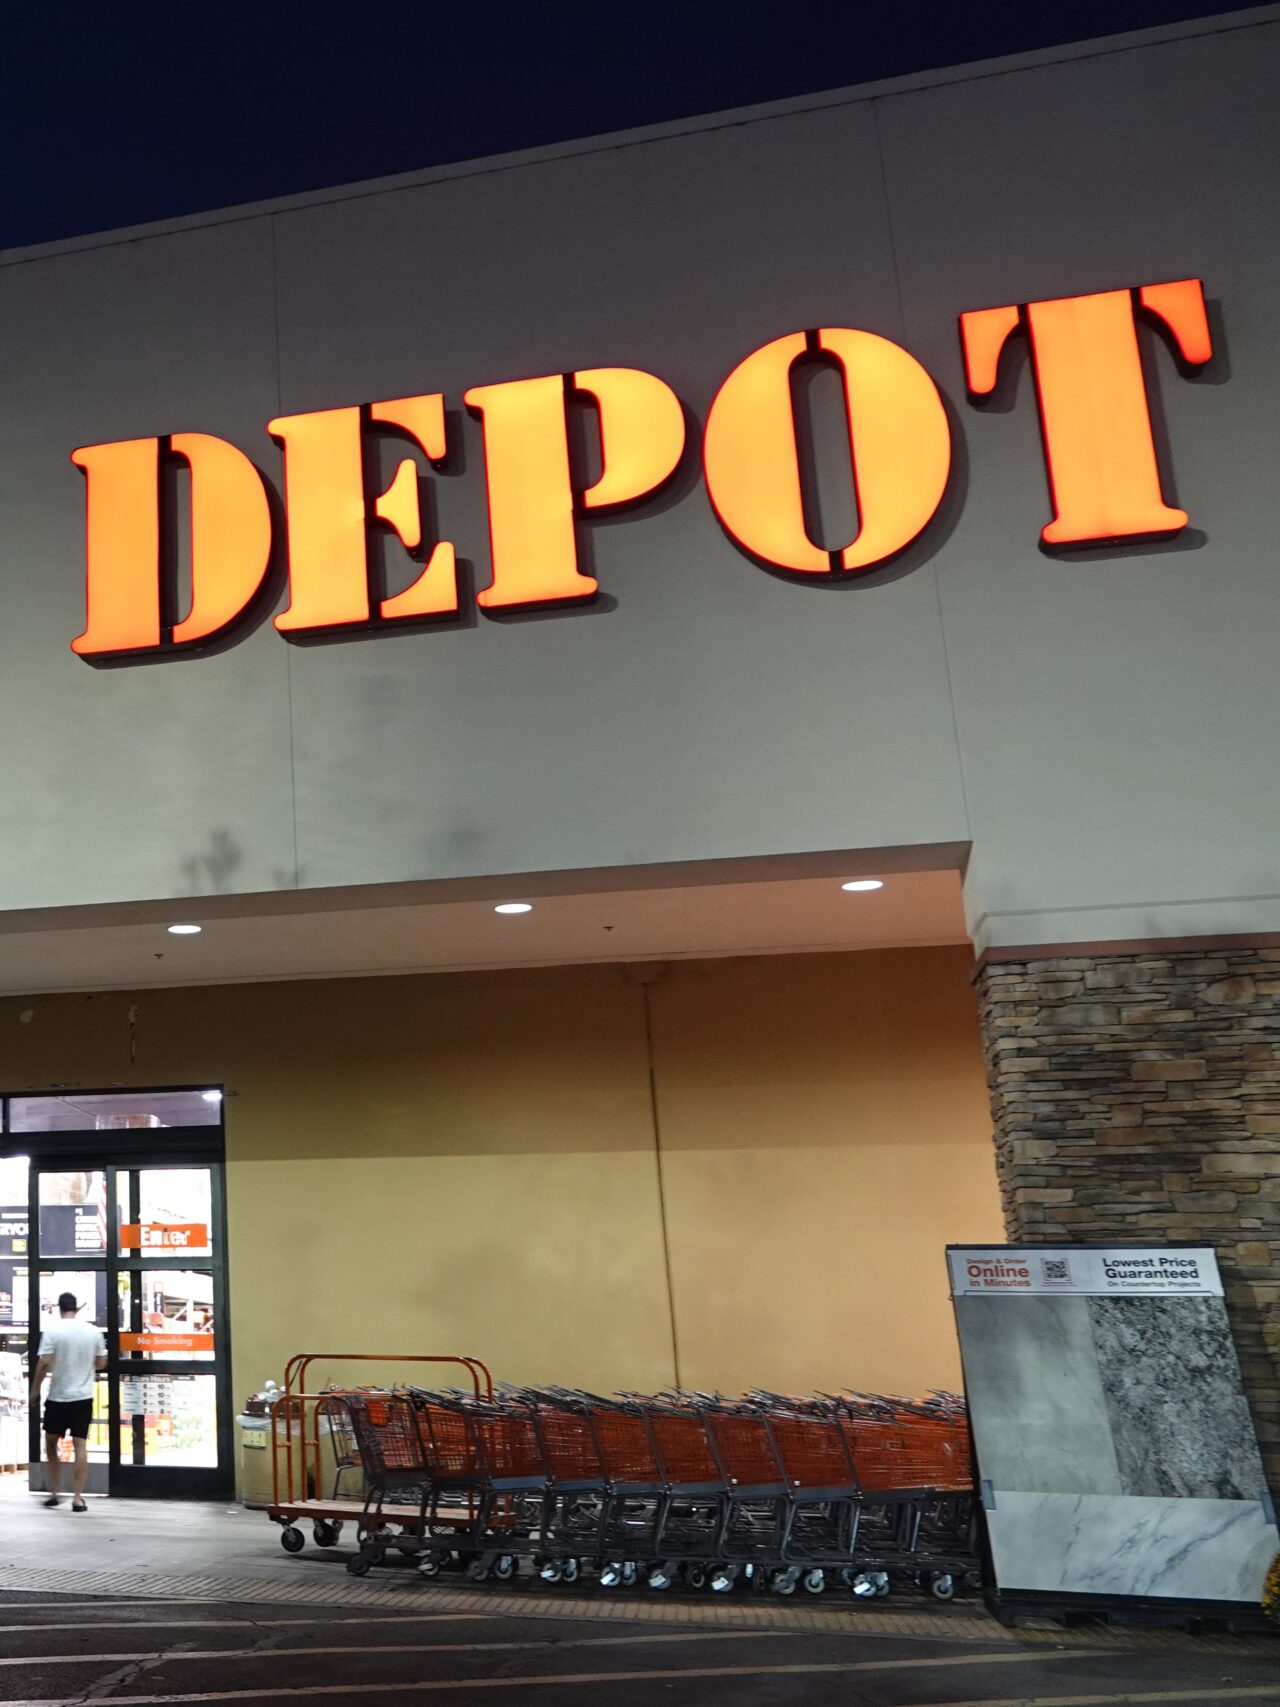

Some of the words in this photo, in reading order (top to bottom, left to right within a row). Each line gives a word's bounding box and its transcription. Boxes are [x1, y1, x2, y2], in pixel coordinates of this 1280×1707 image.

[70, 278, 1213, 655] DEPOT
[0, 1222, 29, 1236] RYO
[140, 1226, 191, 1247] Enter
[1102, 1257, 1155, 1268] Lowest
[1158, 1257, 1198, 1268] Price
[966, 1264, 1030, 1278] Online
[1104, 1267, 1199, 1280] Guaranteed
[970, 1278, 981, 1287] in
[983, 1278, 1032, 1288] Minutes
[1120, 1281, 1166, 1289] Countertop
[1167, 1281, 1202, 1289] Projects
[137, 1336, 151, 1345] No
[153, 1336, 193, 1346] Smoking
